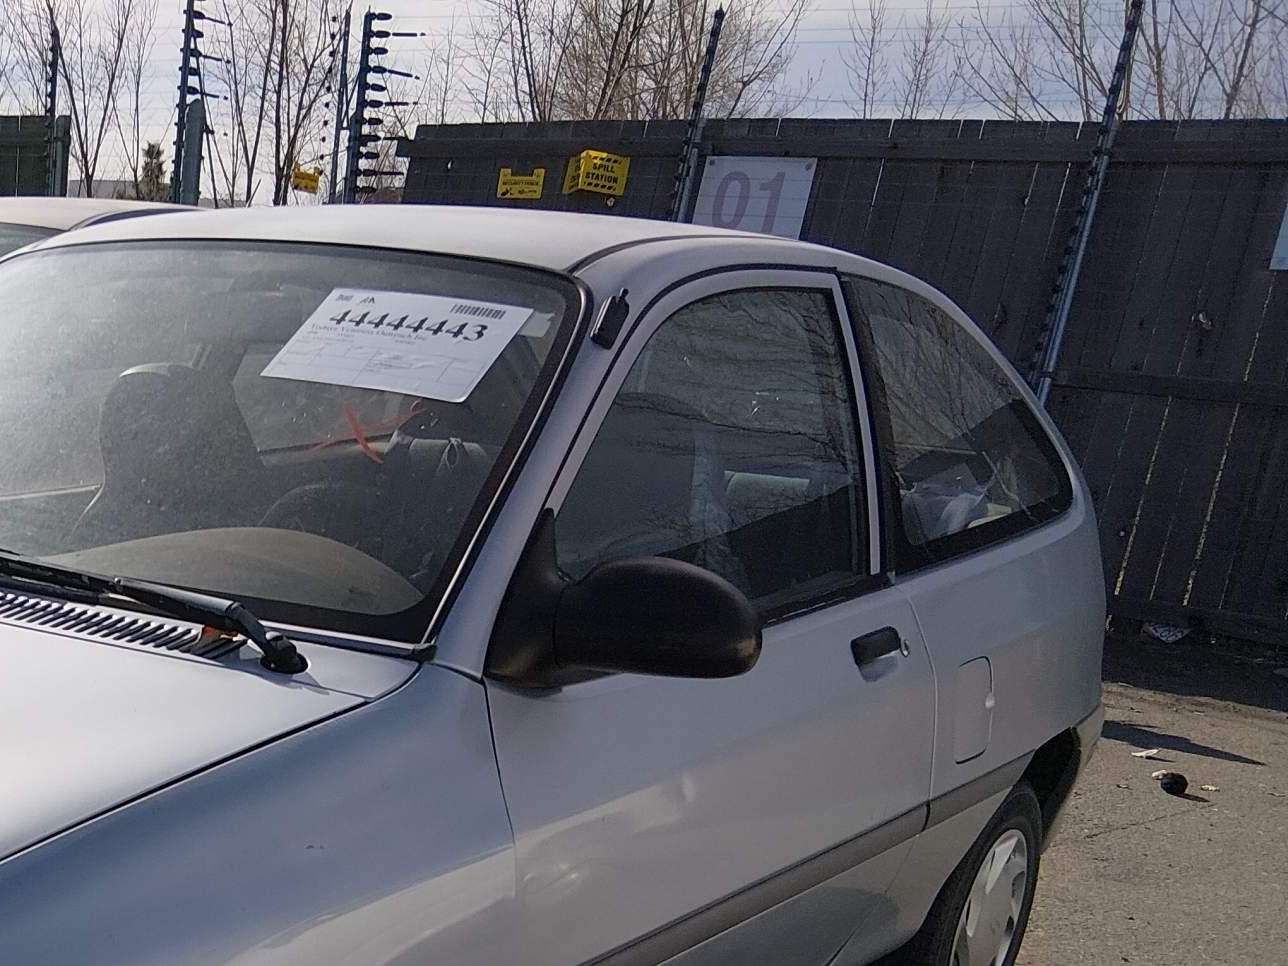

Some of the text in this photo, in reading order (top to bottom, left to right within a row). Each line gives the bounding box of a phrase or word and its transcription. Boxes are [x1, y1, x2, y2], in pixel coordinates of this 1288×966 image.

[585, 171, 619, 185] STATION
[592, 162, 615, 174] SPILL
[712, 170, 786, 234] 01
[329, 309, 488, 342] 44444443
